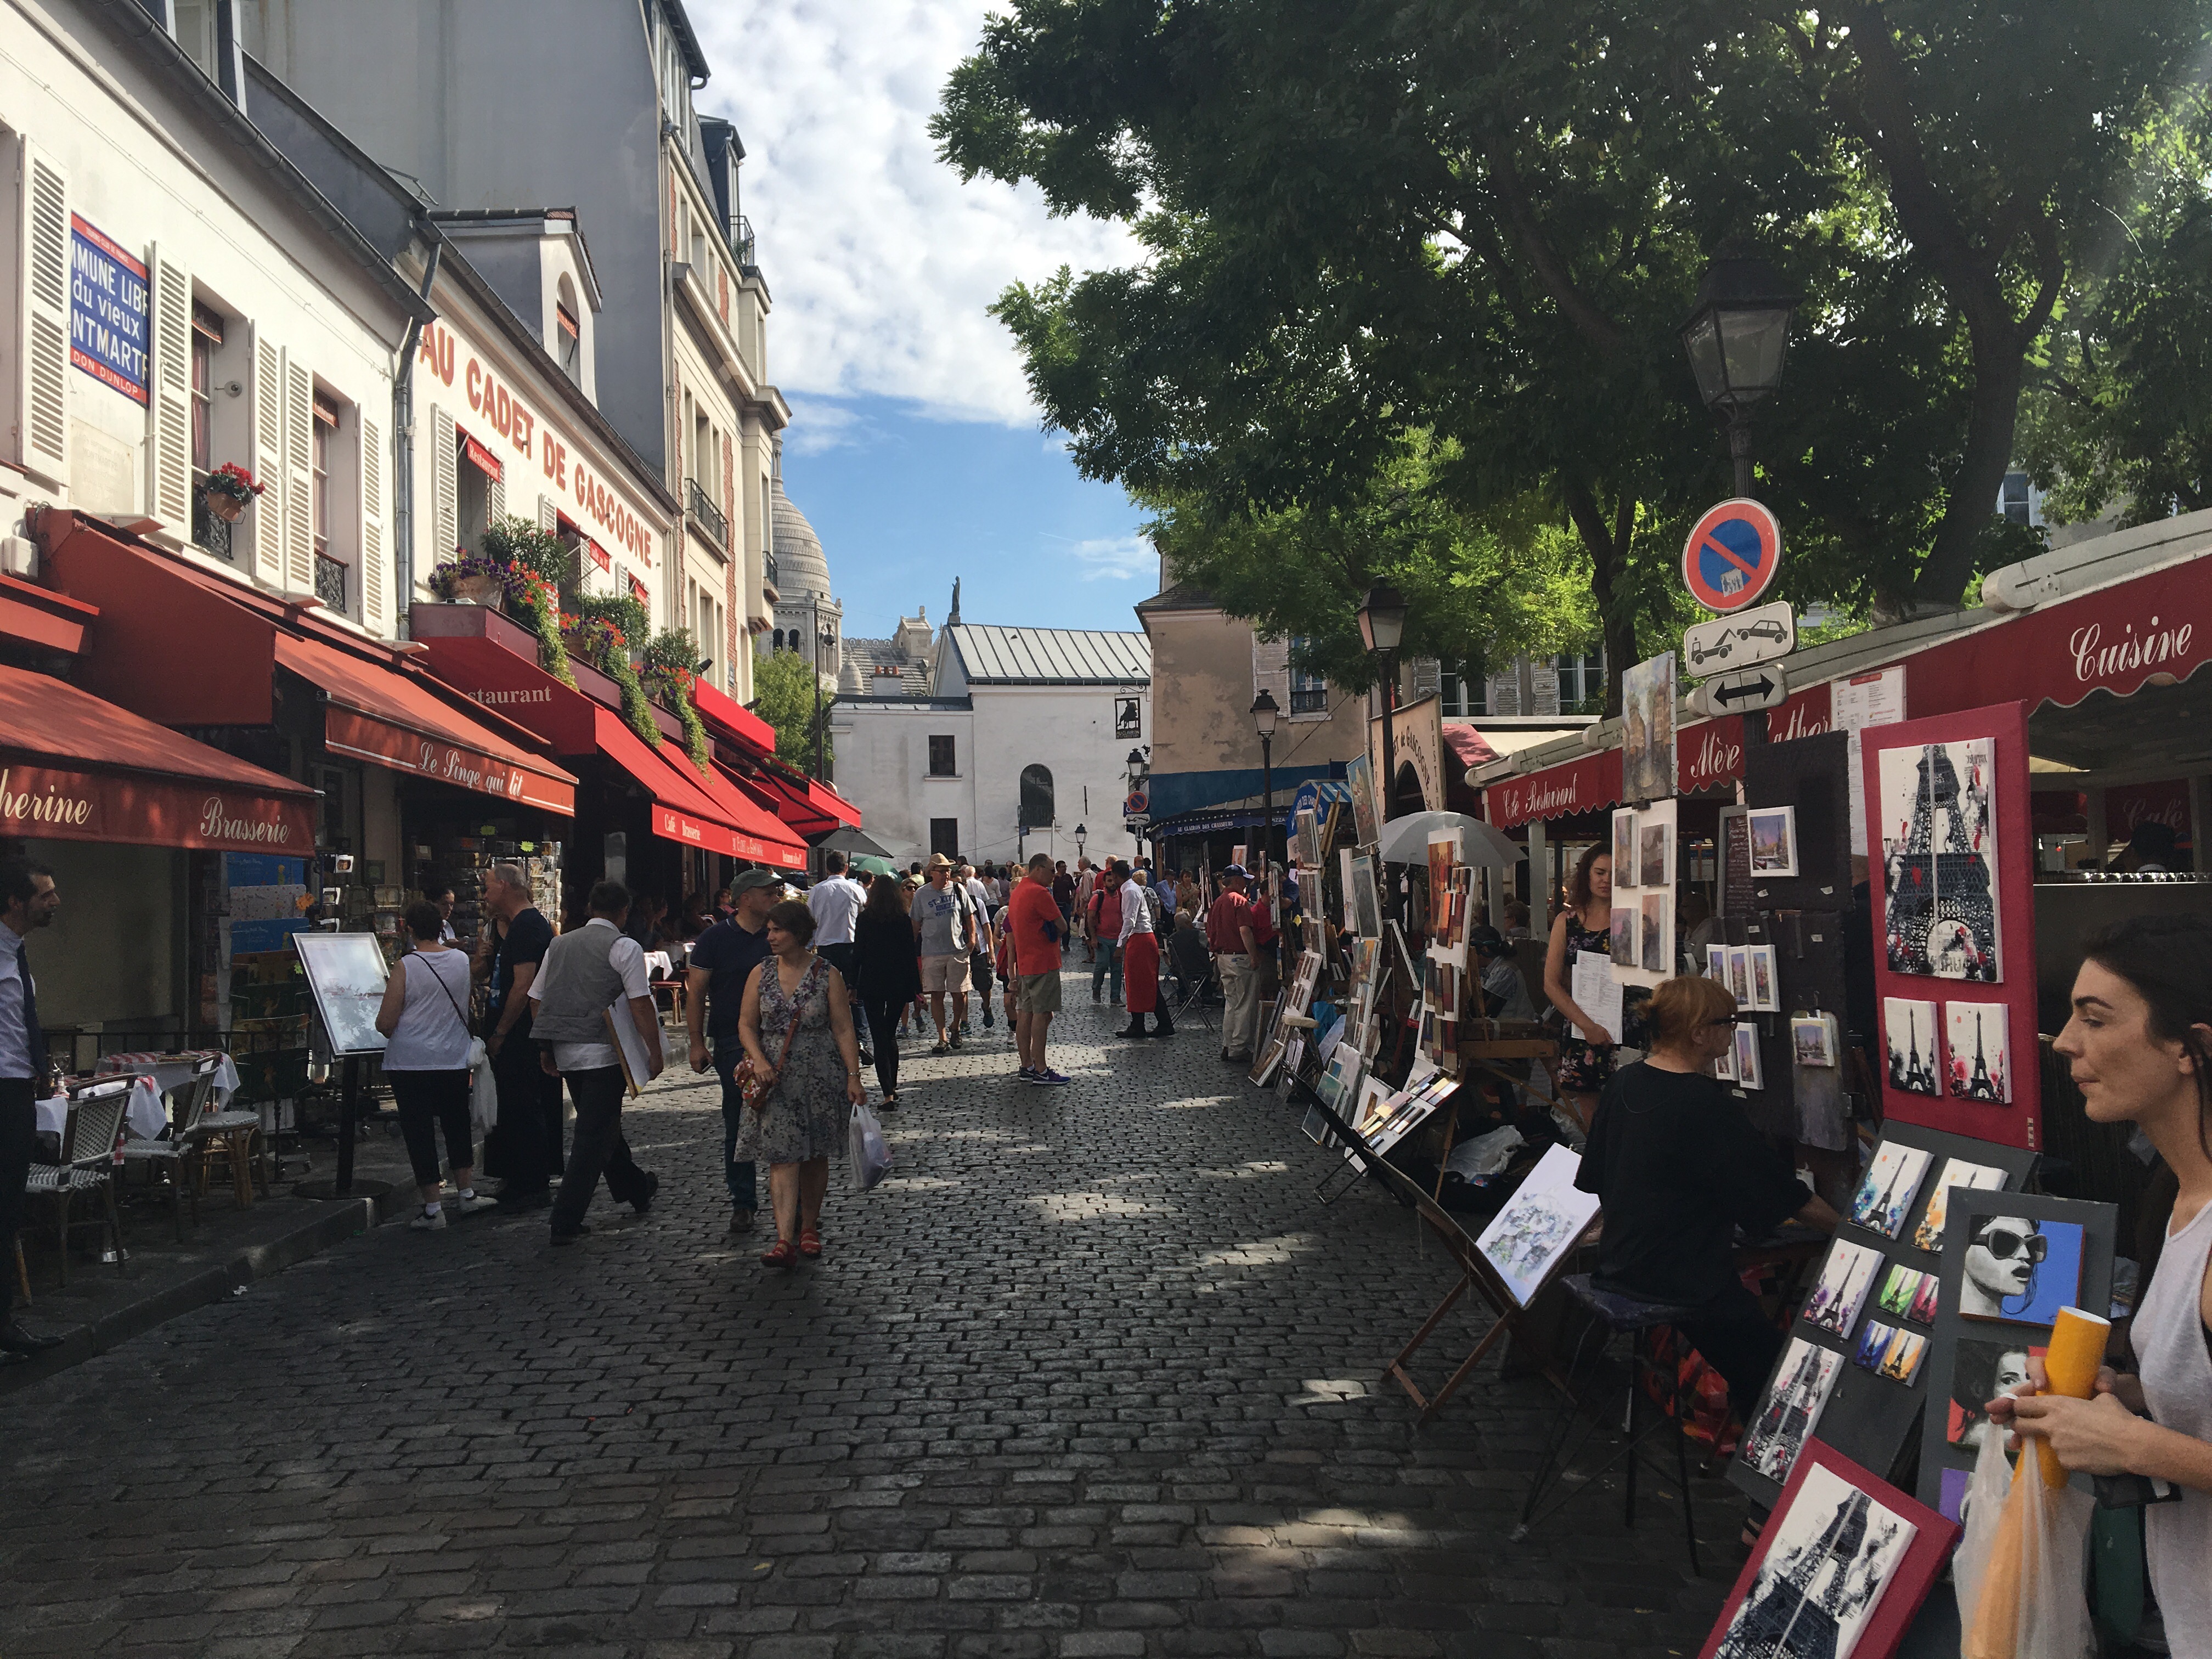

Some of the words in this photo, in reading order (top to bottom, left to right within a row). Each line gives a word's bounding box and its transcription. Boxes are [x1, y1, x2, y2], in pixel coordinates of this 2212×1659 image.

[73, 274, 92, 309] du
[97, 295, 140, 340] vieux
[74, 351, 95, 371] DON
[99, 366, 138, 395] DUNLOP
[419, 323, 454, 387] AU
[466, 358, 534, 460] CADET
[543, 430, 566, 492] DE
[574, 463, 652, 570] GASCOGNE
[469, 443, 499, 479] Restaurant
[2070, 616, 2192, 681] Cuisine
[419, 742, 437, 774] Le
[443, 749, 480, 789] Singe
[485, 771, 506, 794] qui
[508, 771, 523, 797] lit
[1406, 725, 1430, 791] GASCOGNE
[1690, 731, 1740, 778] Mère
[1526, 772, 1578, 813] Restaurant
[200, 797, 292, 844] Brasserie
[664, 813, 676, 833] Café
[682, 820, 701, 841] Brasserie
